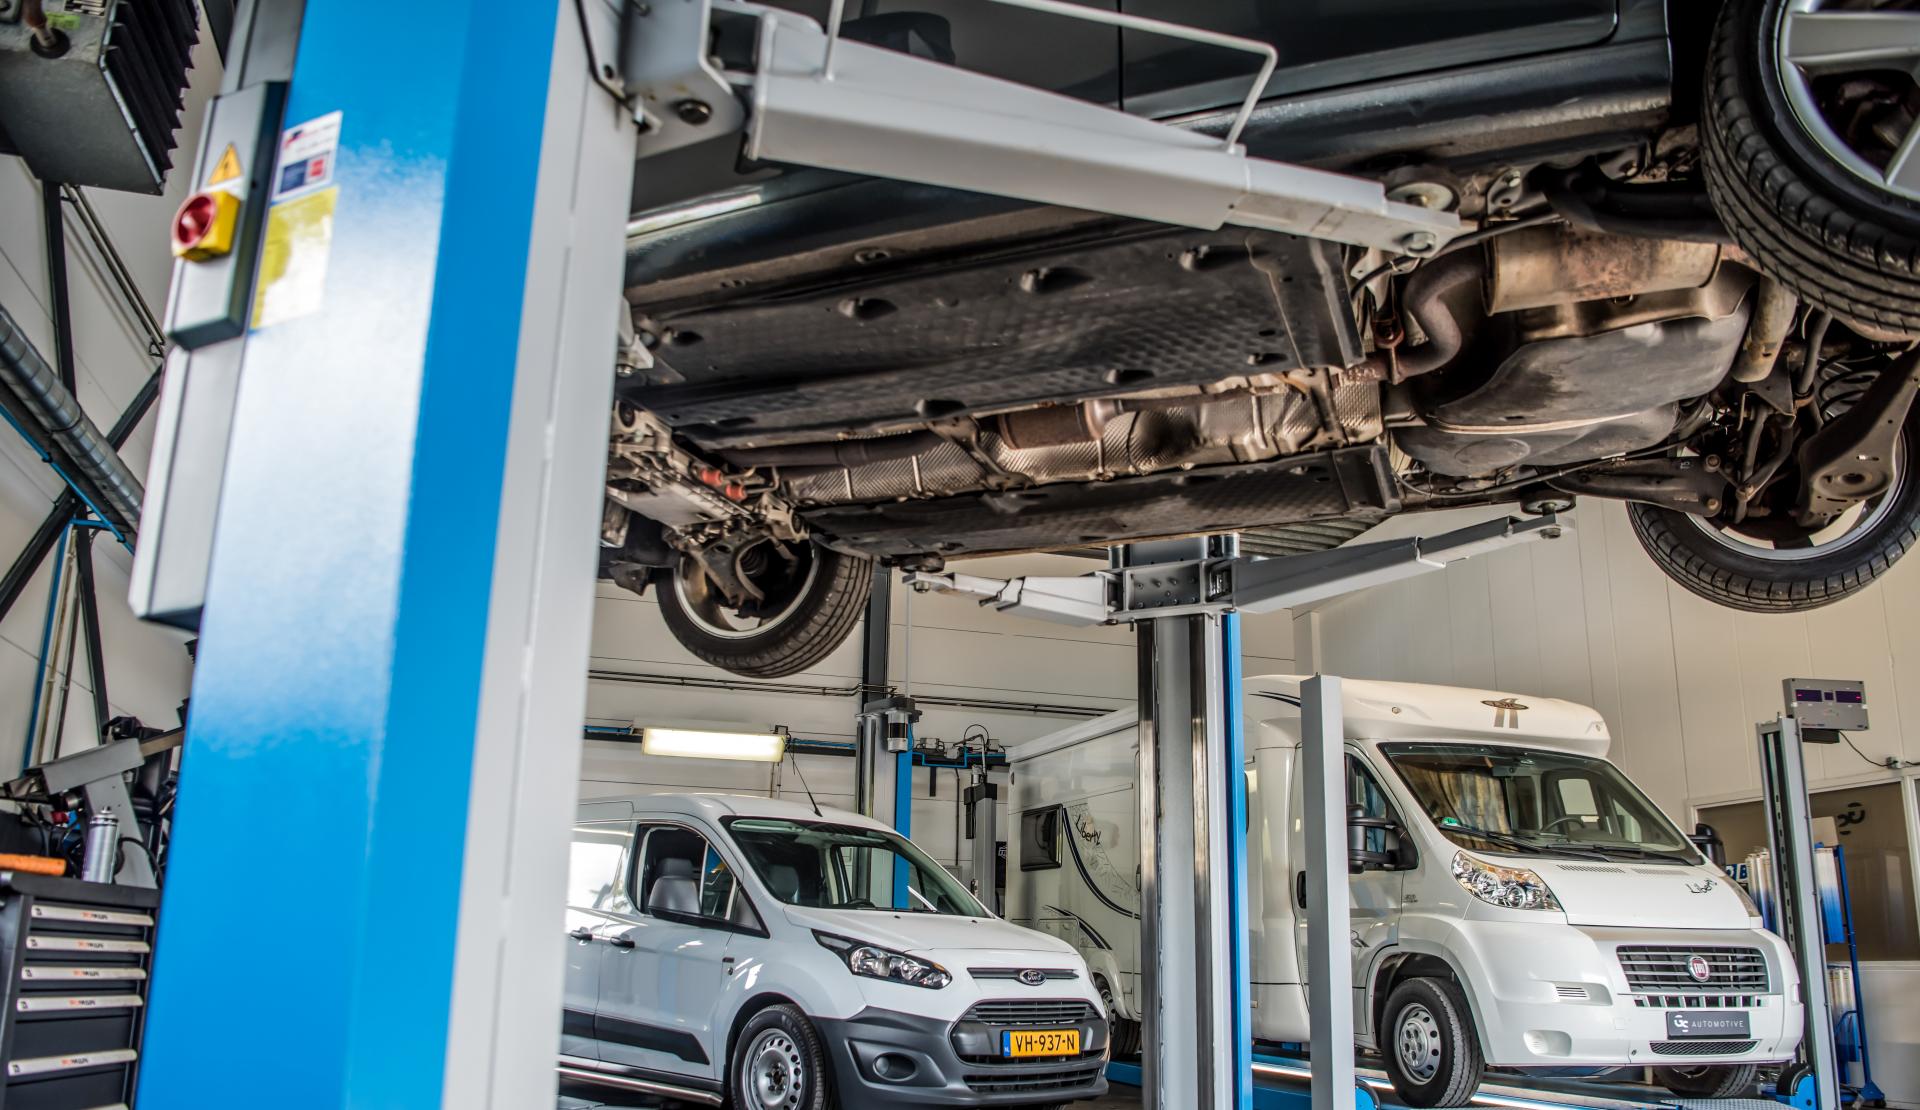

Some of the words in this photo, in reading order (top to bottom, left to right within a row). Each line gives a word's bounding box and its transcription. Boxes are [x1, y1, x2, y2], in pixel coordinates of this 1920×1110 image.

[1075, 814, 1102, 846] Liberty
[1691, 1020, 1745, 1028] AUTOMOTIVE
[1015, 1034, 1075, 1052] VH-937-N
